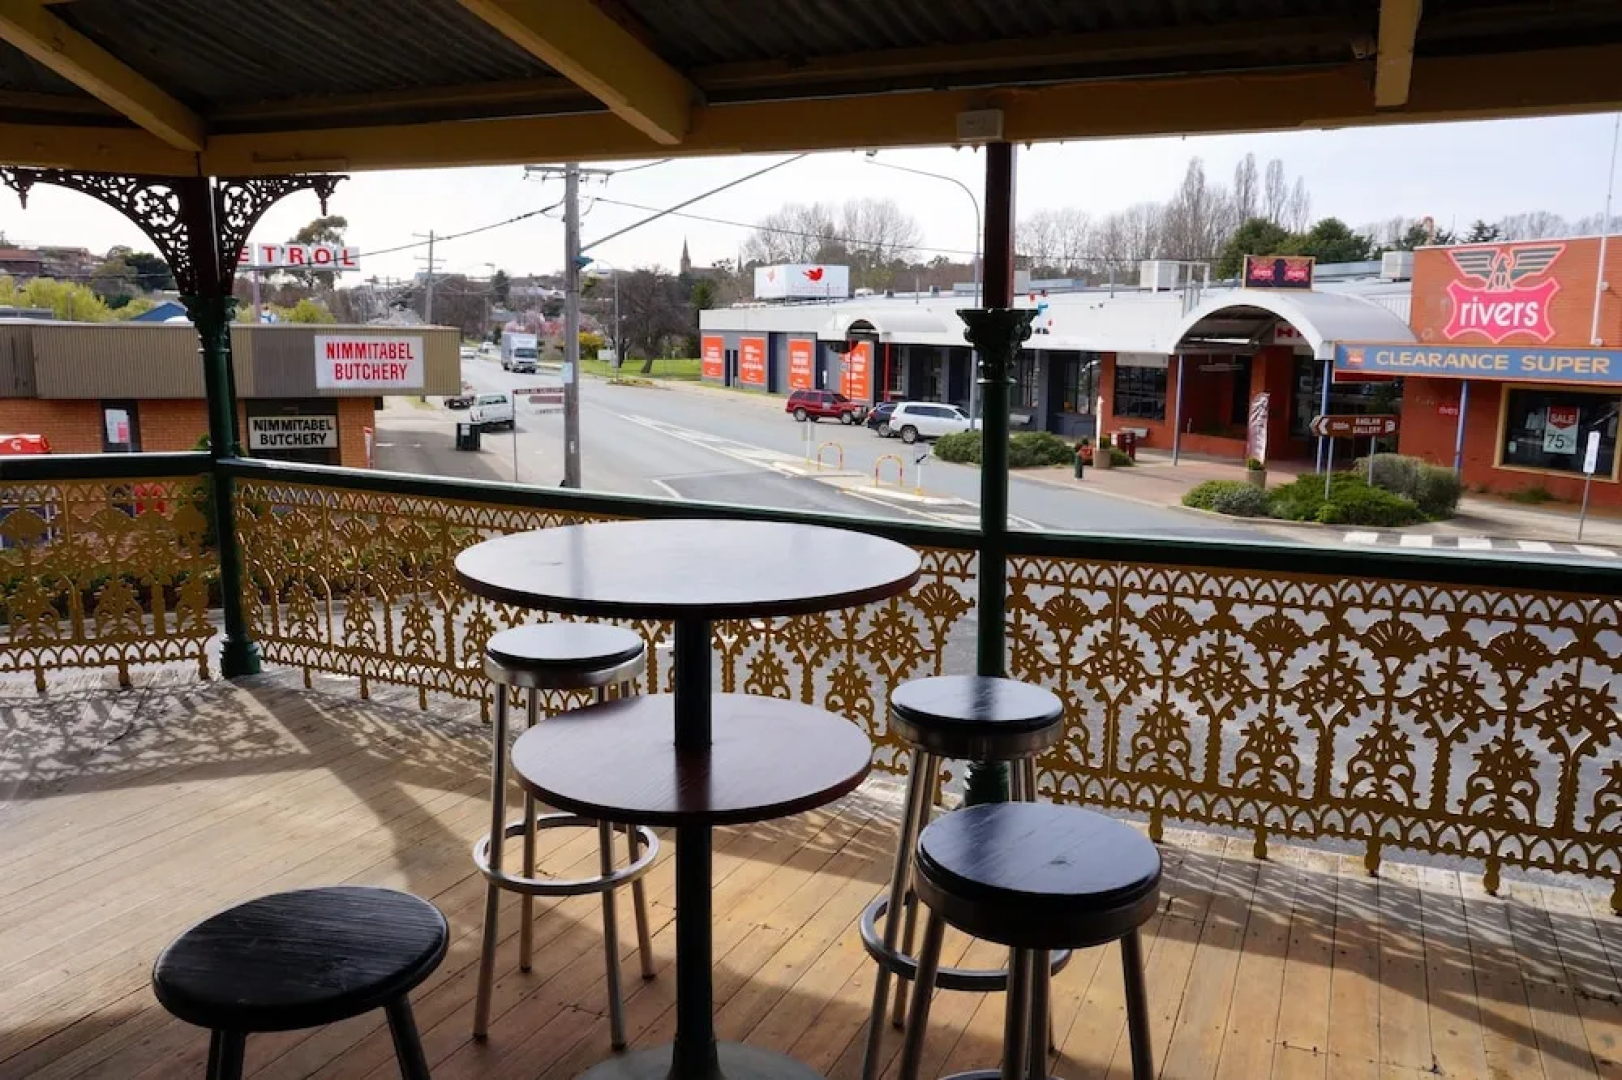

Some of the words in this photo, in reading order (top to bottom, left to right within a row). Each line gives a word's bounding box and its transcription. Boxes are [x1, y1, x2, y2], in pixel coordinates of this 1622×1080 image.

[238, 246, 355, 265] ETROL
[1460, 296, 1539, 327] rivers
[326, 342, 414, 359] NIMMITABEL
[1376, 351, 1508, 370] CLEARANCE
[1521, 354, 1610, 374] SUPER
[335, 363, 408, 380] BUTCHERY
[254, 419, 333, 431] NIMMITABEL
[1550, 413, 1576, 424] SALE
[260, 433, 327, 445] BUTCHERY
